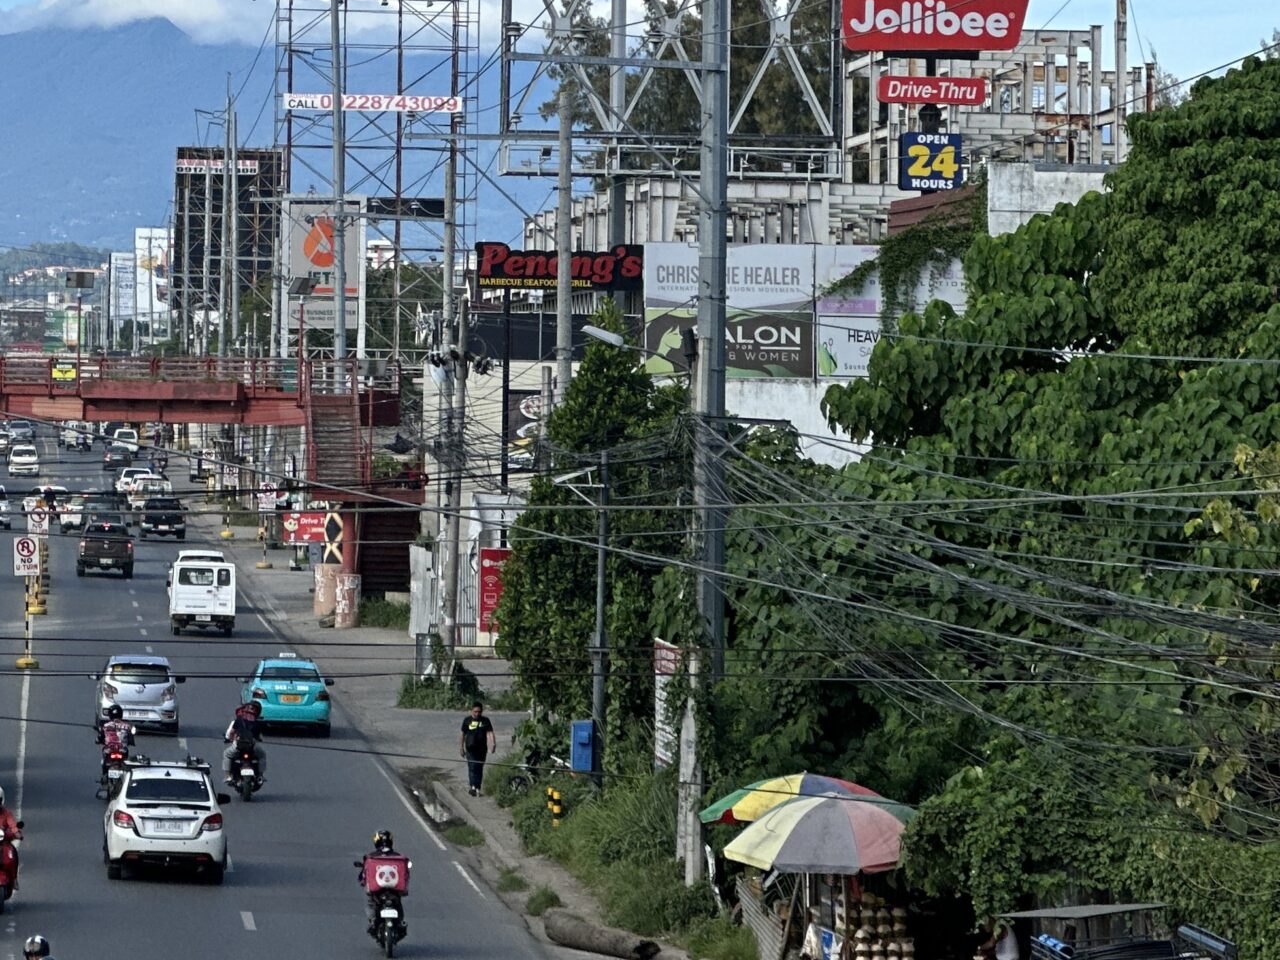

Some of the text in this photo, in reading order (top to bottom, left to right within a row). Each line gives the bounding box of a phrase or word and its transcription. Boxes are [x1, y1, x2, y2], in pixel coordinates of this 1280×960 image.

[887, 80, 978, 100] Drive-Thru
[288, 95, 458, 111] CALL 0228743099
[917, 134, 949, 144] OPEN
[906, 144, 959, 179] 24
[911, 178, 954, 190] HOURS
[479, 277, 522, 286] BARBECUE
[656, 264, 700, 284] CHRIS
[744, 266, 801, 286] HEALER
[728, 351, 800, 362] & WOMEN
